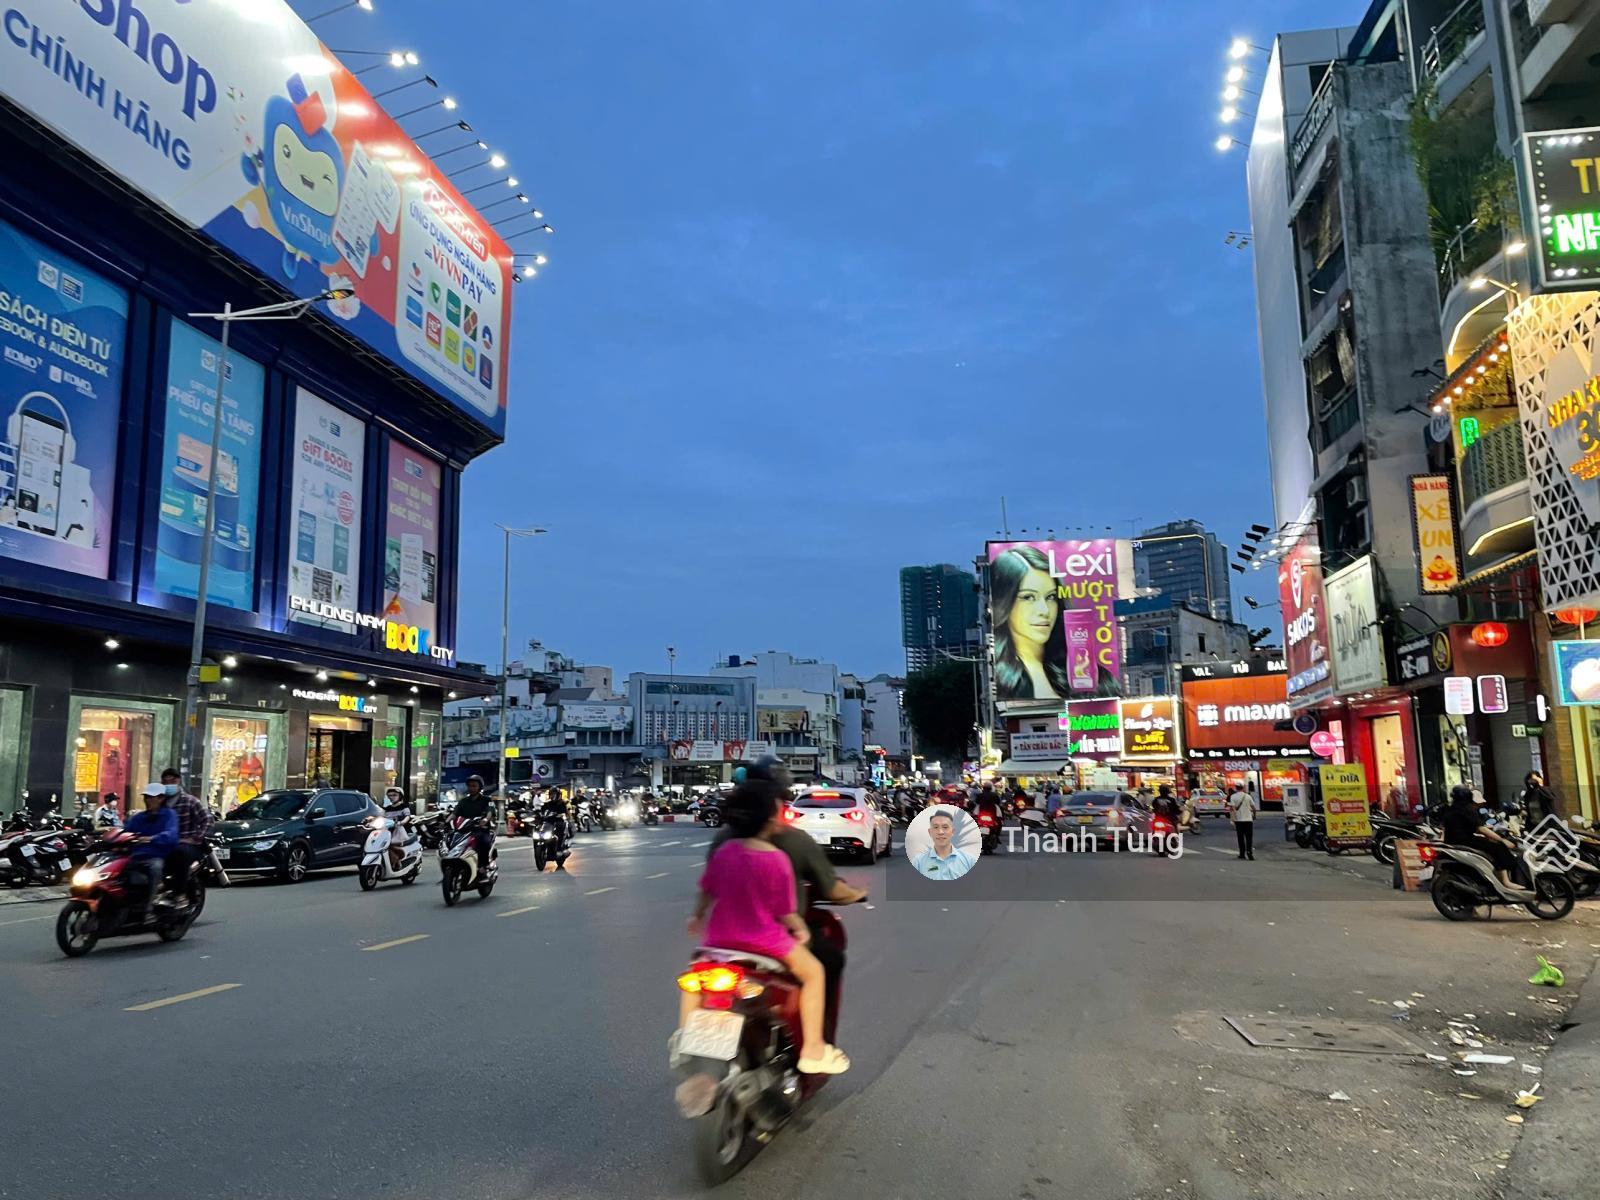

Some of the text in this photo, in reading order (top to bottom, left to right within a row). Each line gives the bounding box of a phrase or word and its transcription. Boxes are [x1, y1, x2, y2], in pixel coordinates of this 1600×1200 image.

[5, 9, 192, 170] CHÍNH HÃNG
[280, 201, 332, 249] VnShop
[1422, 530, 1453, 548] UN
[1057, 579, 1115, 603] MƯỢT
[356, 612, 385, 632] NAM
[386, 621, 429, 656] BOOK
[431, 645, 454, 660] CITY
[1287, 607, 1315, 646] SAKOS
